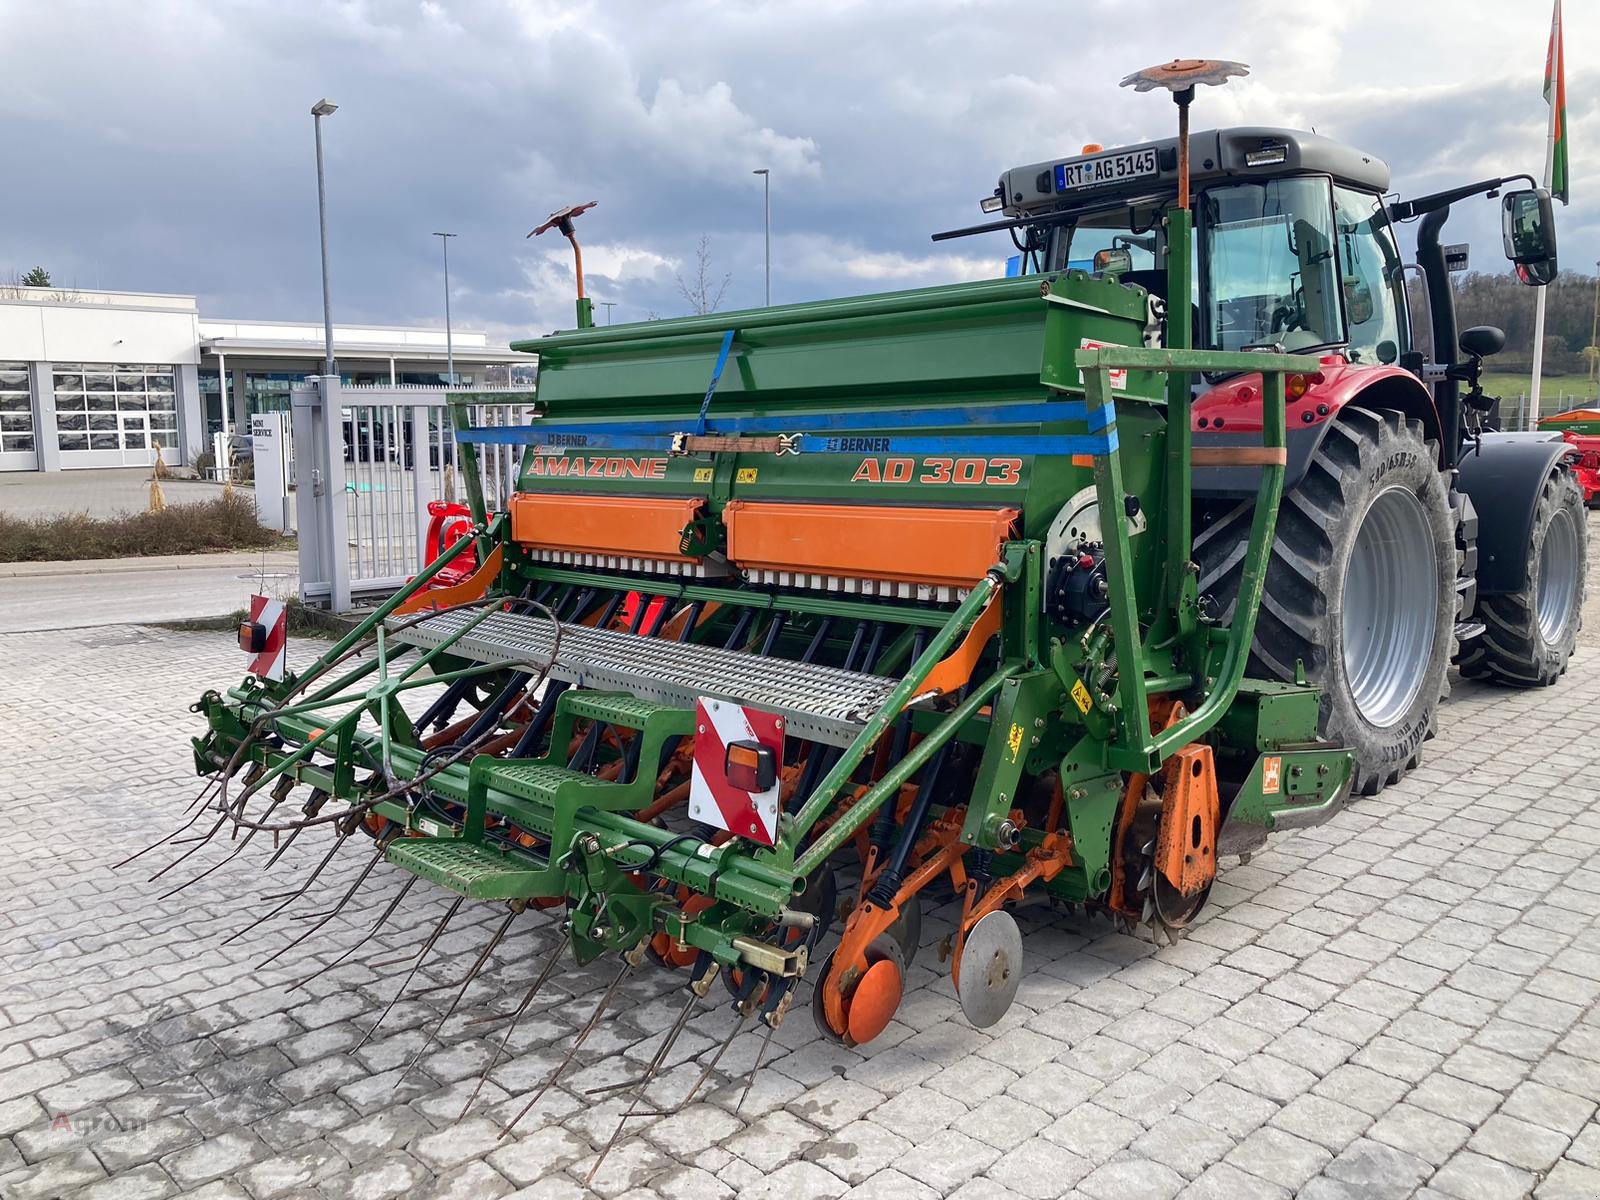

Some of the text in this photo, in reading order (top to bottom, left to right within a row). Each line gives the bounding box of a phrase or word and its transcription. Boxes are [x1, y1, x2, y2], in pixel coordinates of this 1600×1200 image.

[1065, 164, 1083, 186] RT
[1095, 159, 1113, 181] AG
[1116, 152, 1155, 177] 5145
[252, 428, 273, 437] SERVICE
[555, 433, 588, 447] BERNER
[840, 437, 890, 452] BERNER
[527, 456, 668, 479] AMAZONE
[851, 457, 1023, 485] AD 303
